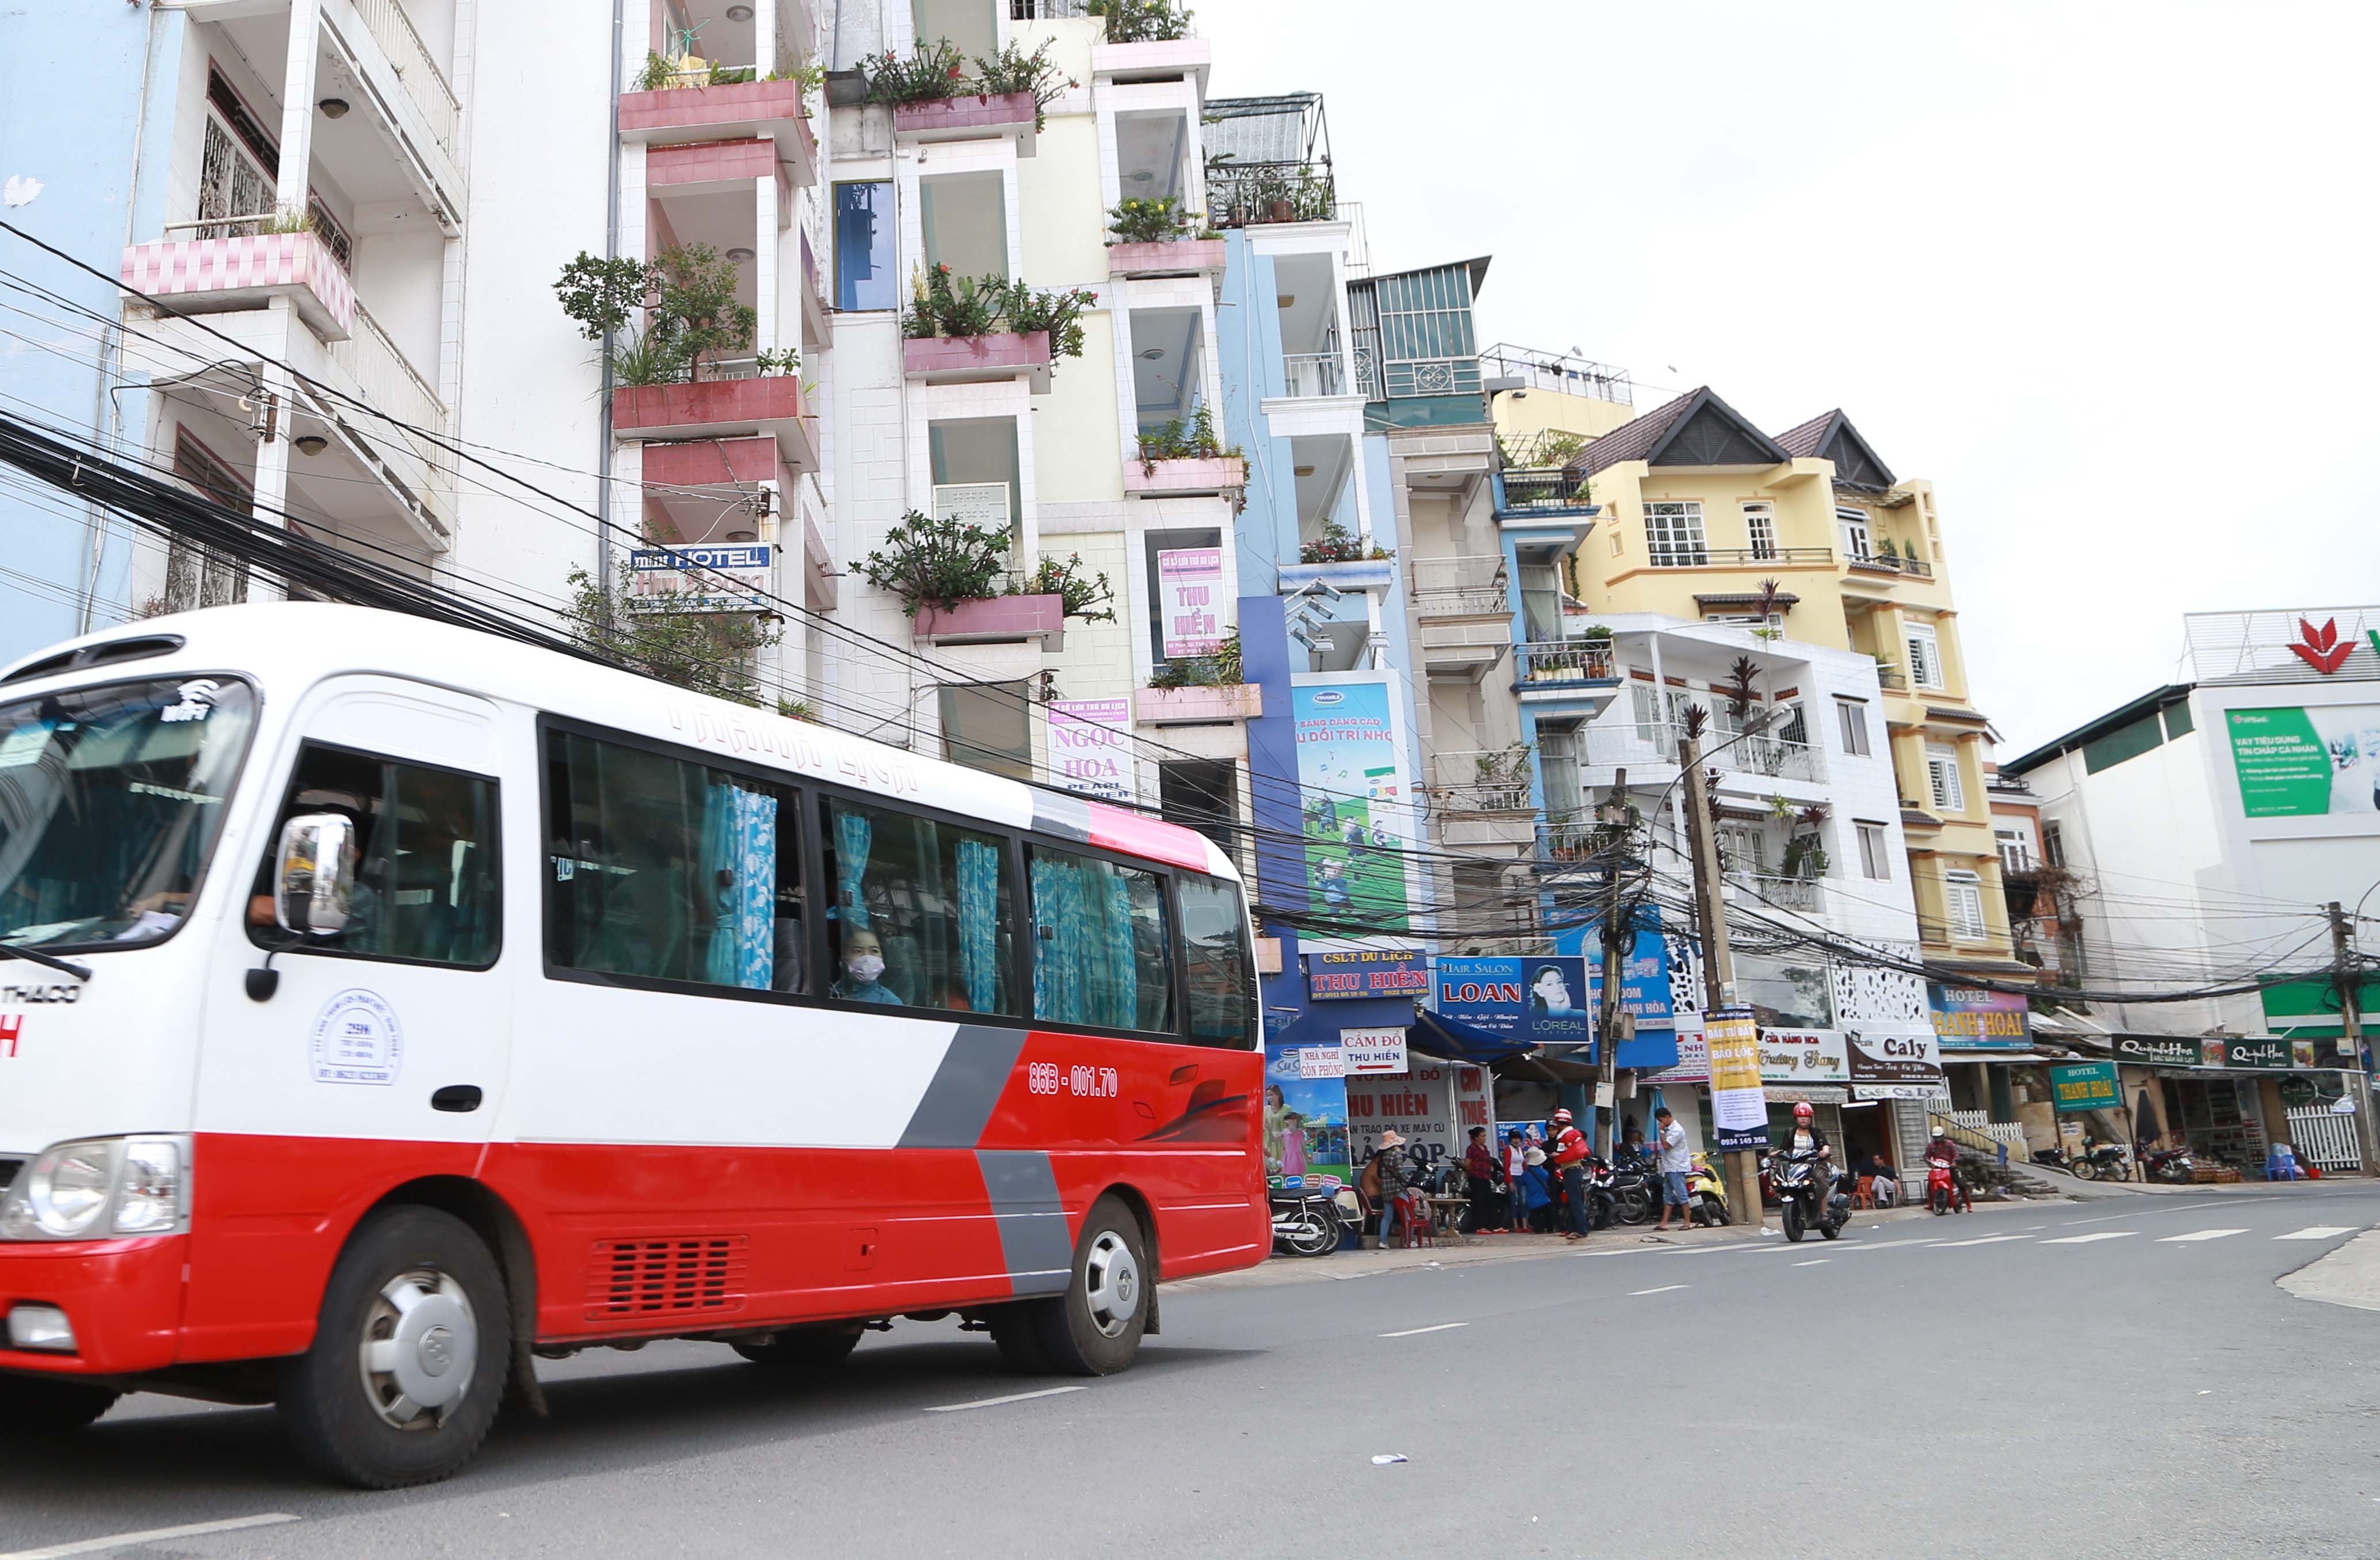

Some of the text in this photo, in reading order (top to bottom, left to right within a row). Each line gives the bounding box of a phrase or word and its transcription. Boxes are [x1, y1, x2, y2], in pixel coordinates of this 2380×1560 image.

[634, 547, 762, 568] mini HOTEL
[1176, 586, 1210, 607] THU
[1360, 718, 1381, 726] CAO
[1054, 726, 1125, 750] NGỌC
[2235, 737, 2253, 746] VAY
[1064, 758, 1120, 778] HOA
[1067, 781, 1123, 791] PEARL
[1323, 951, 1414, 964] CSLT DU LỊCH
[1442, 963, 1514, 974] HAIR SALON
[1311, 973, 1361, 991] THU
[3, 985, 80, 1004] THACO
[1443, 982, 1522, 1003] LOAN
[1944, 989, 1993, 1003] HOTEL
[1982, 1006, 2024, 1036] HOÀI
[1344, 1030, 1402, 1047] CẦM ĐỒ
[1804, 1036, 1820, 1044] HOA
[1304, 1050, 1320, 1061] NHÀ
[1884, 1038, 1927, 1059] Caly
[1348, 1053, 1369, 1062] THU
[1301, 1061, 1344, 1077] CÒN PHÒNG
[2068, 1067, 2099, 1077] HOTEL
[1029, 1062, 1059, 1094] 86B
[1071, 1065, 1118, 1097] 001.70
[1460, 1067, 1482, 1092] CHO
[1348, 1094, 1374, 1117] HU
[1460, 1094, 1489, 1126] THUÊ
[1361, 1124, 1381, 1134] TRAO
[1400, 1123, 1410, 1133] XE
[1413, 1122, 1431, 1133] MÁY
[1721, 1138, 1738, 1146] 0934
